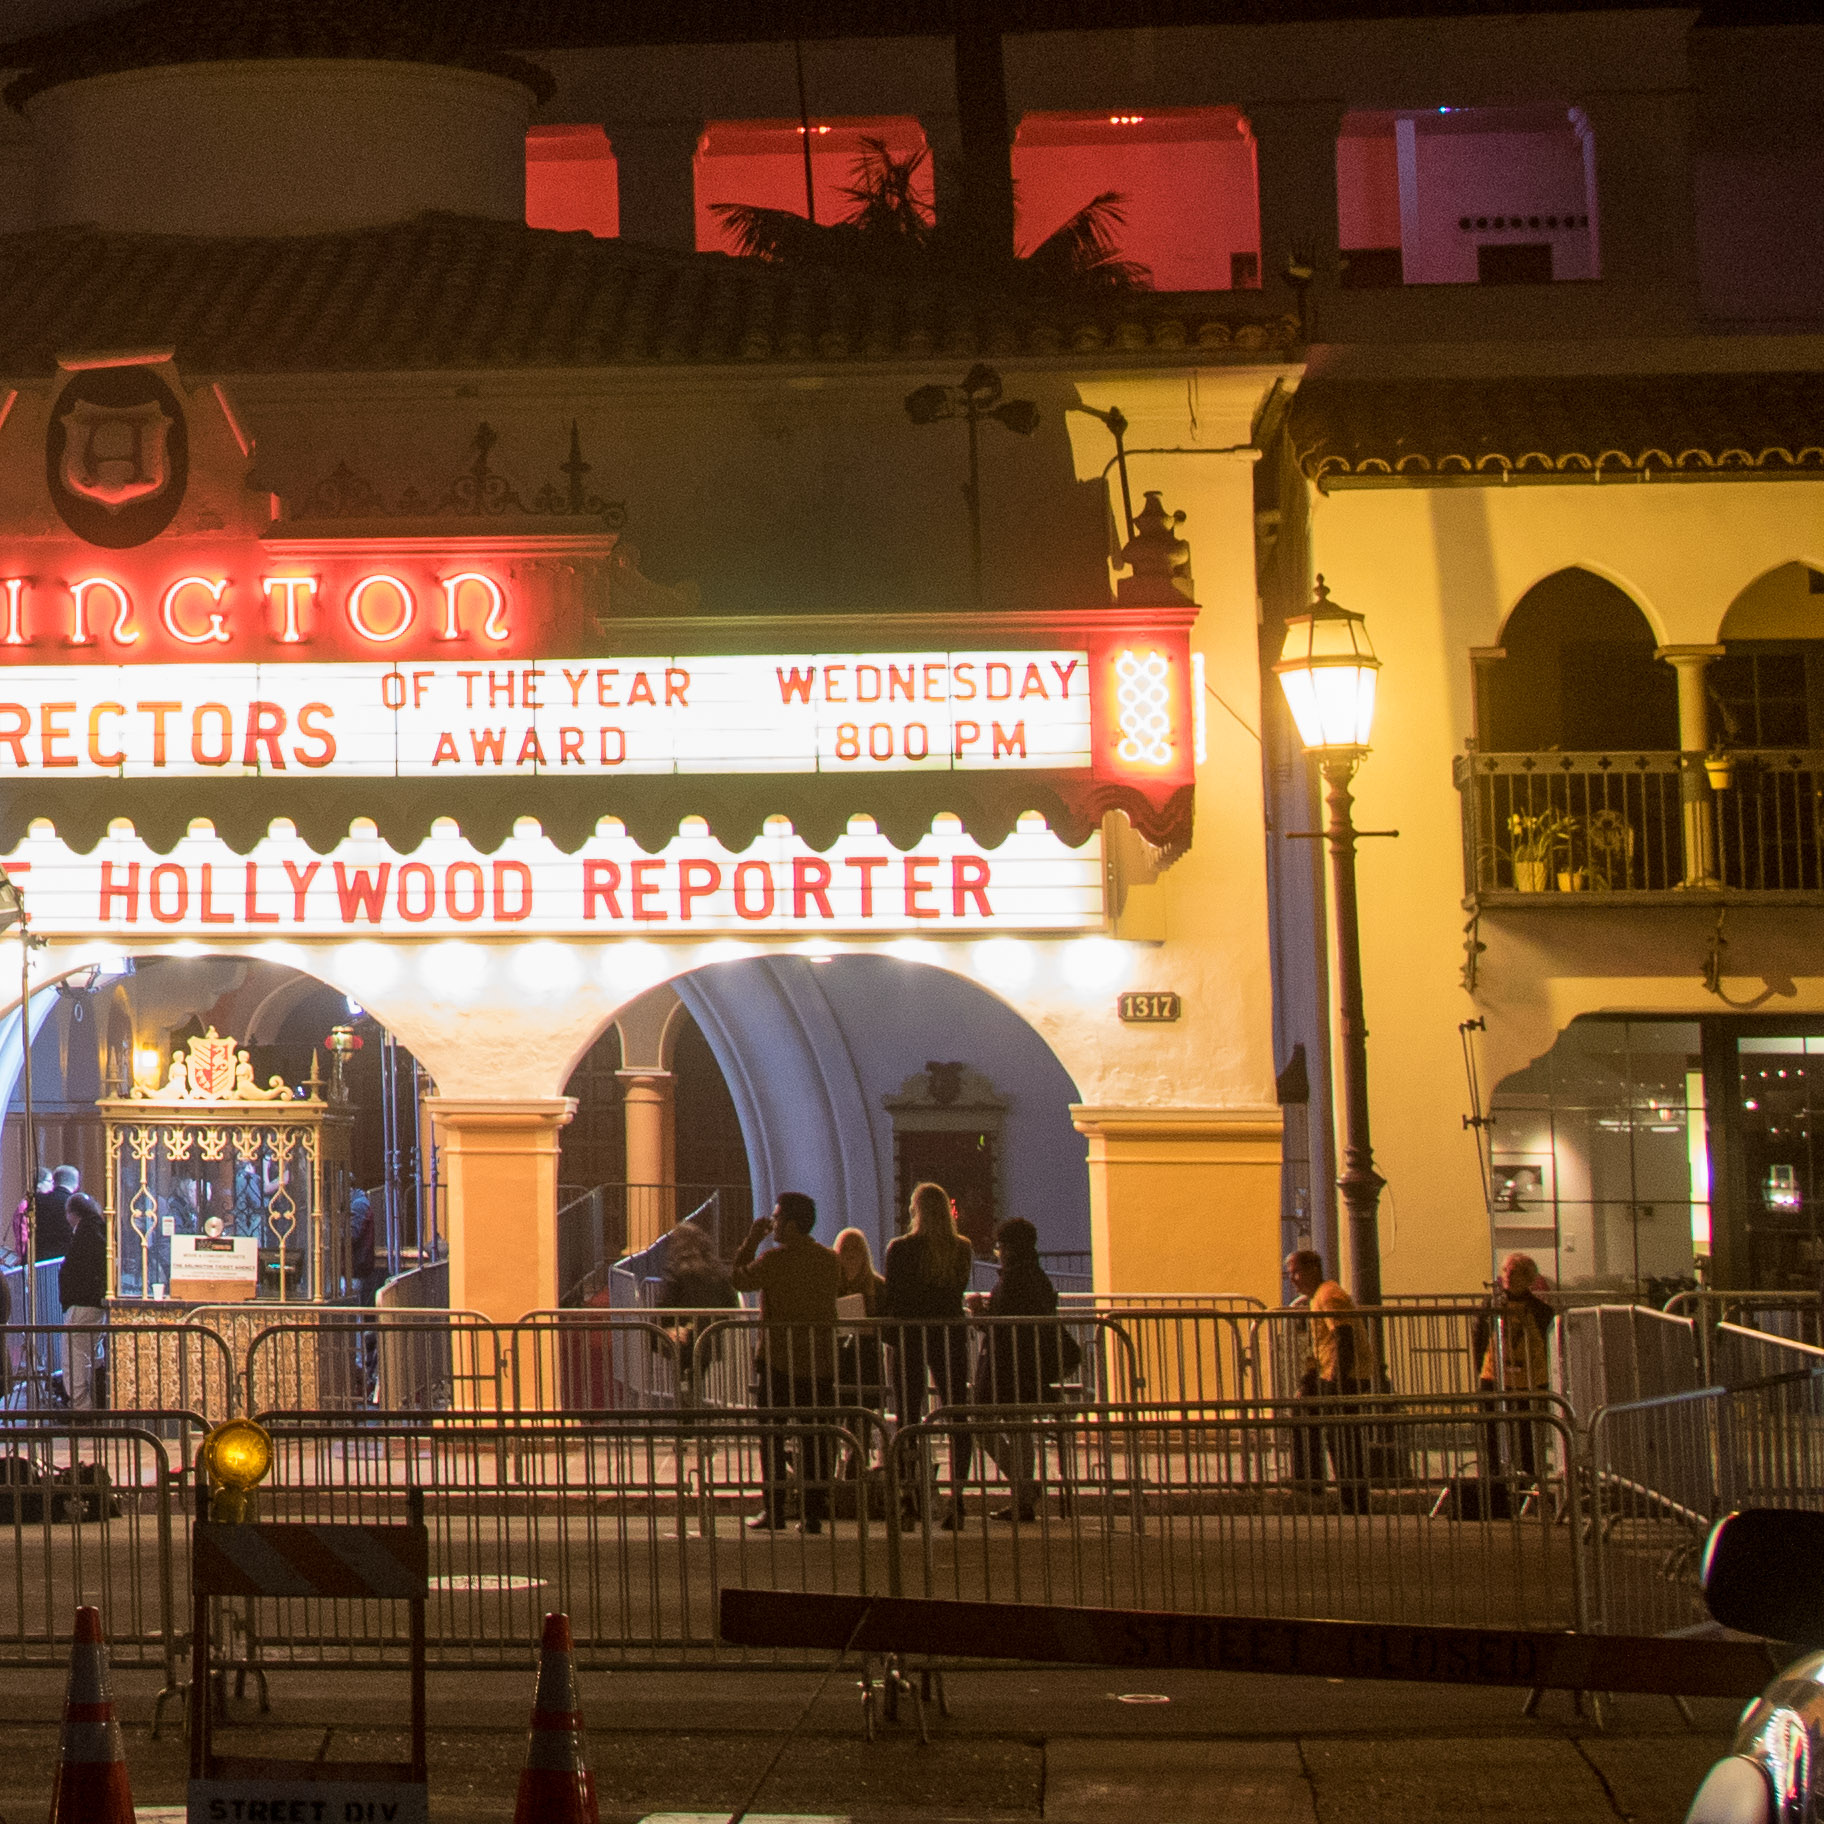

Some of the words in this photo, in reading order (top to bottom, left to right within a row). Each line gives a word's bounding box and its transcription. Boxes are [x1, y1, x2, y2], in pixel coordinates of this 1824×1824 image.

[381, 670, 436, 712] OF
[456, 668, 547, 712] THE
[560, 667, 691, 709] YEAR
[776, 658, 1081, 705] WEDNESDAY
[432, 726, 630, 768] AWARD
[954, 719, 1028, 762] PM
[98, 859, 534, 925] HOLLYWOOD
[582, 854, 996, 923] REPORTER
[1124, 996, 1173, 1017] 1317
[208, 1798, 327, 1823] STREET
